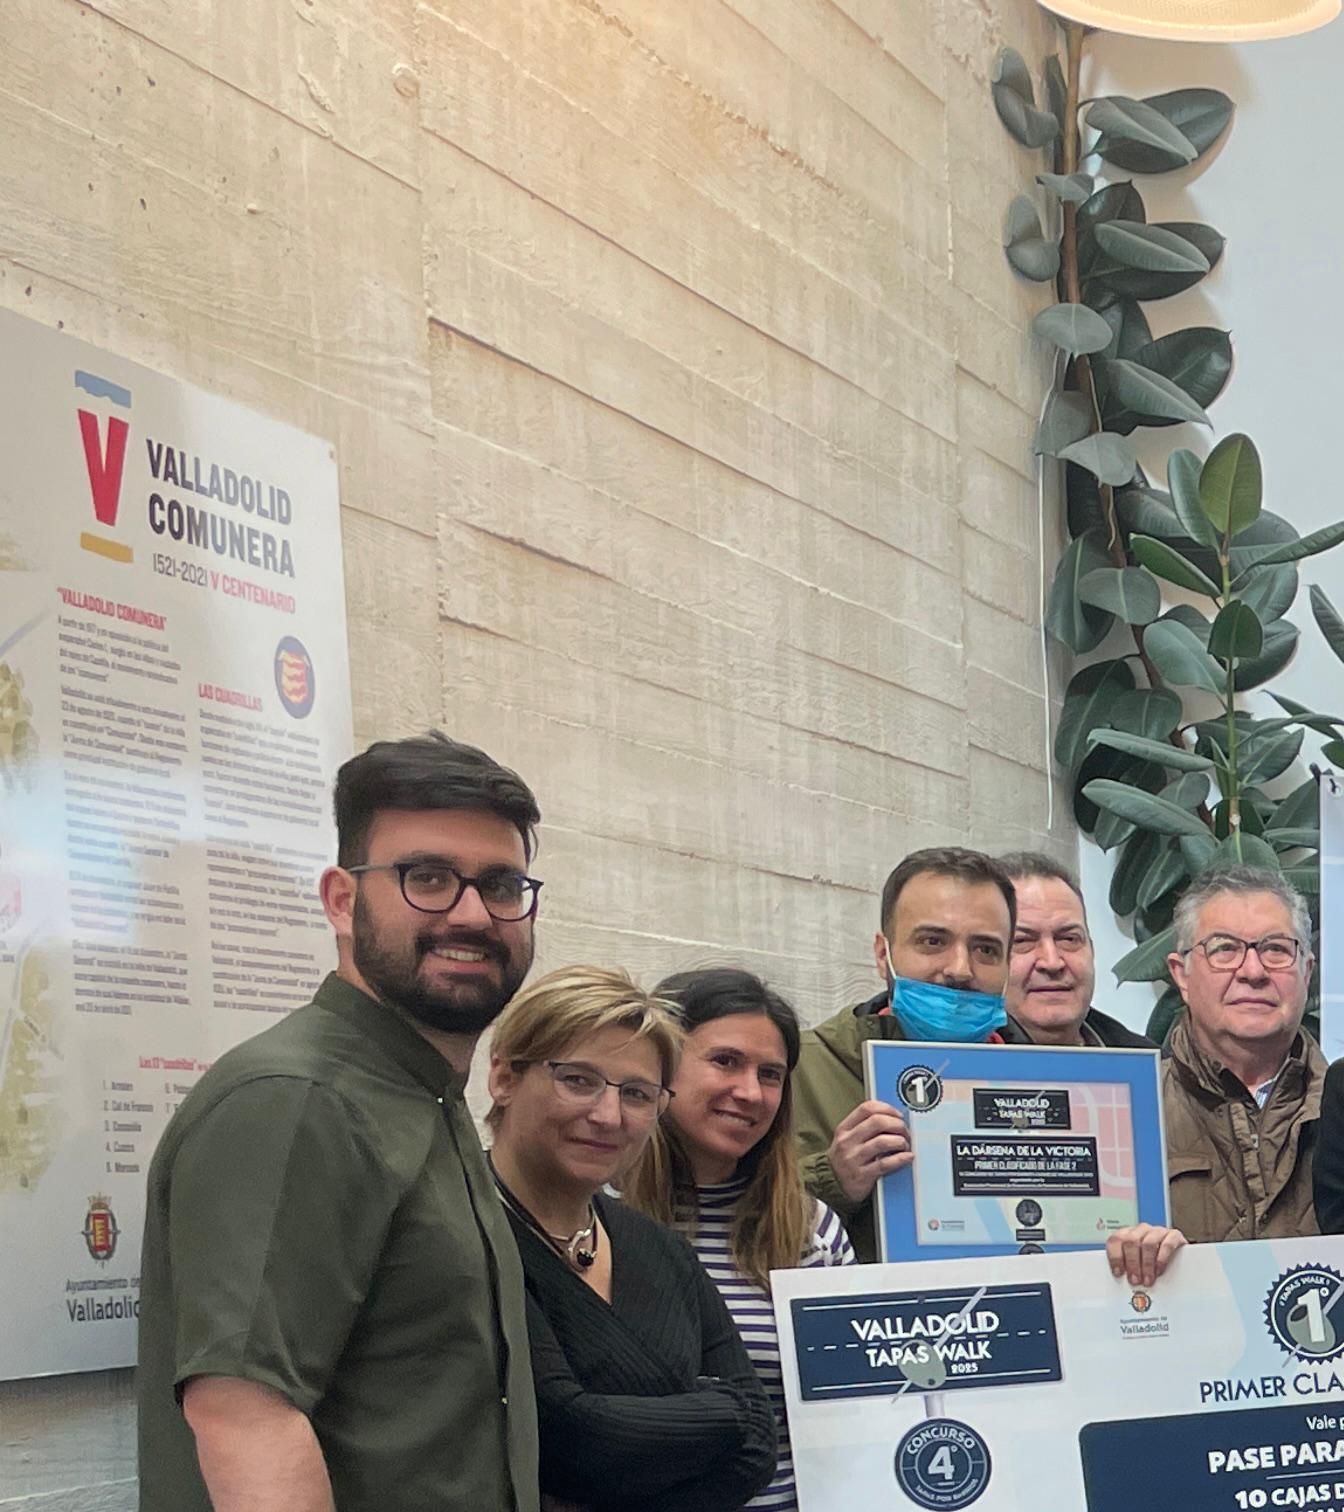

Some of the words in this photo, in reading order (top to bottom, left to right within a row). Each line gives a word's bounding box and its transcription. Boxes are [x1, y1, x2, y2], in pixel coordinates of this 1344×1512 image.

[146, 439, 291, 525] VALLADOLID
[149, 493, 295, 578] COMUNERA
[153, 553, 208, 587] 1521-2021
[210, 571, 219, 590] V
[222, 575, 295, 613] CENTENARIO
[957, 1146, 970, 1156] LA
[1017, 1146, 1030, 1156] DE
[1031, 1146, 1044, 1156] LA
[1046, 1146, 1091, 1157] VICTORIA
[851, 1311, 999, 1340] VALLADOLID
[1120, 1322, 1169, 1334] Valladolid
[866, 1346, 930, 1367] TAPAS
[932, 1341, 992, 1361] WALK
[951, 1363, 978, 1374] 2025
[1200, 1375, 1287, 1403] PRIMER
[1306, 1415, 1336, 1430] Vale
[907, 1427, 975, 1454] CONCURSO
[1208, 1447, 1275, 1473] PASE
[1235, 1490, 1267, 1509] 10
[1271, 1484, 1331, 1508] CAJAS
